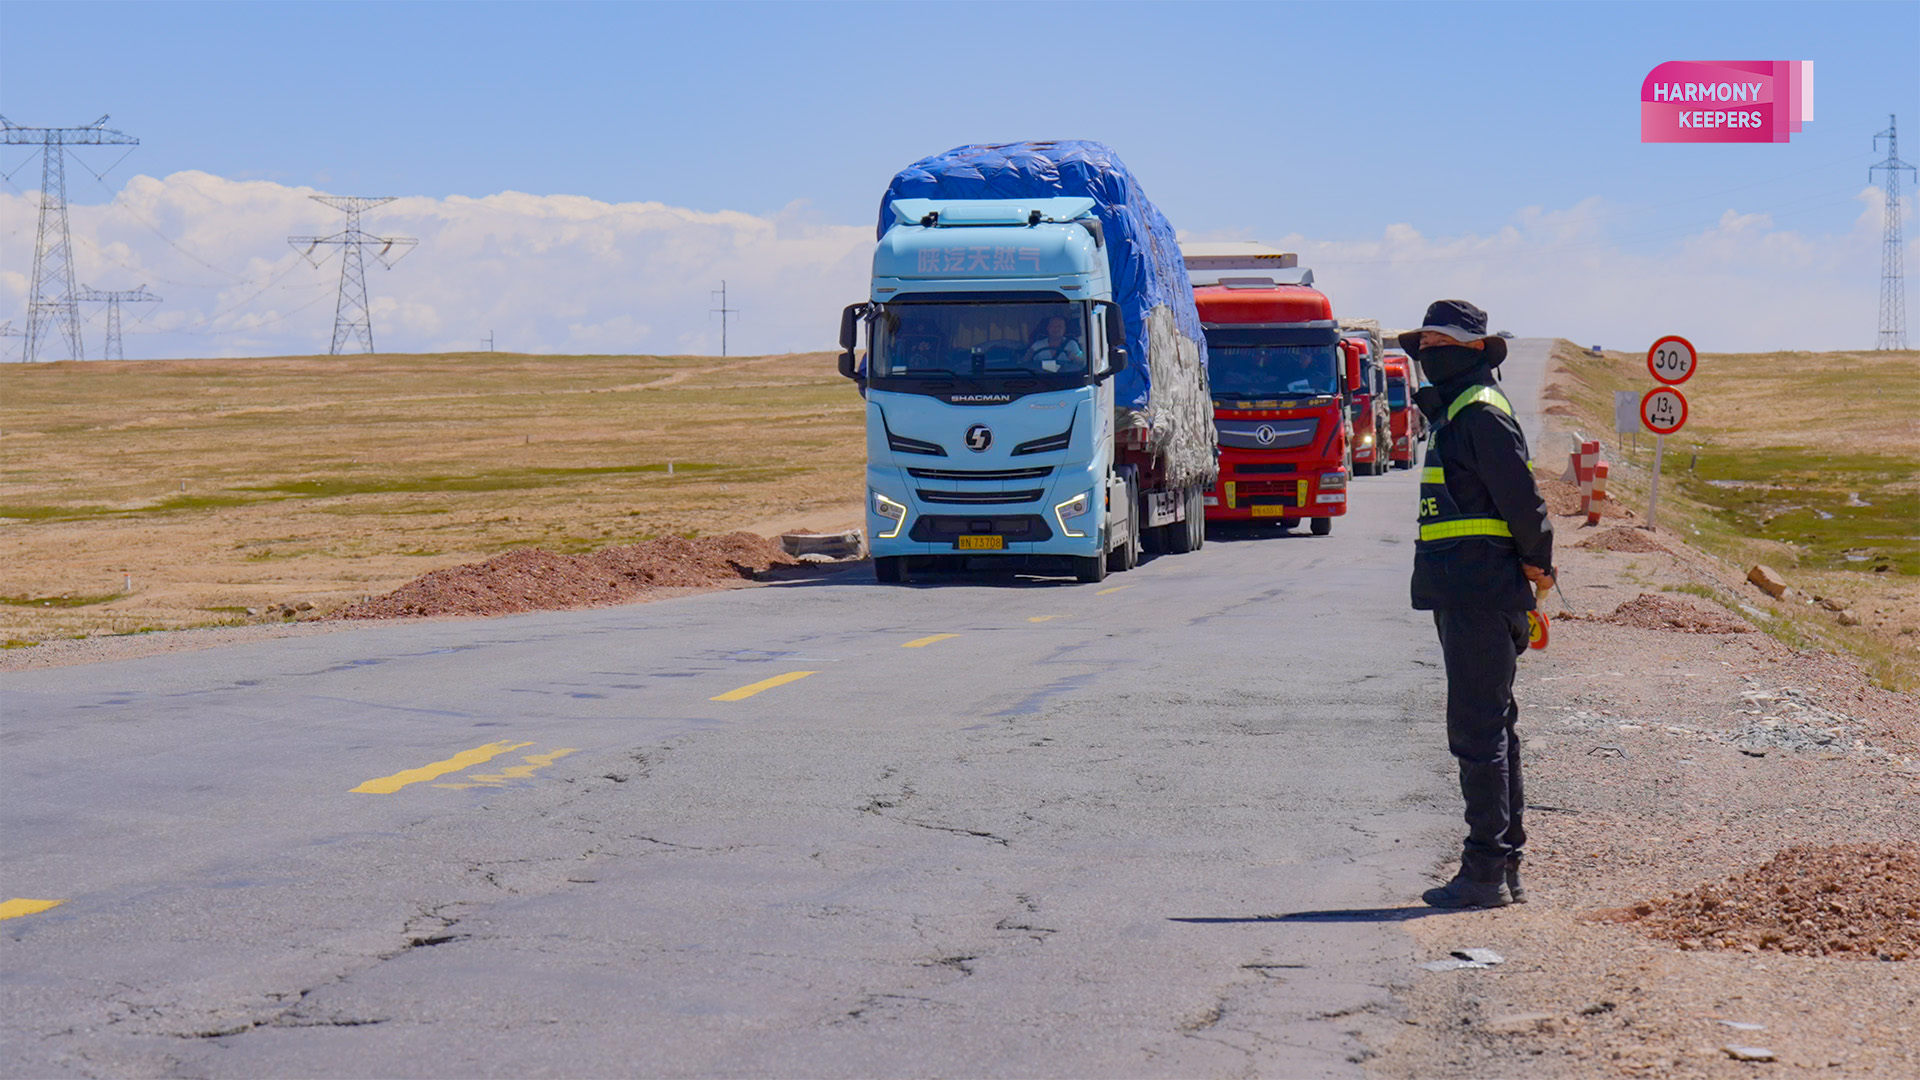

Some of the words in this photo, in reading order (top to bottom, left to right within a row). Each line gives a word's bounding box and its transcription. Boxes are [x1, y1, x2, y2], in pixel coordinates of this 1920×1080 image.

[917, 245, 1041, 273] 陕汽天然气
[1655, 349, 1687, 372] 30t
[951, 394, 1010, 402] SHACMAN
[1657, 396, 1673, 414] 13t
